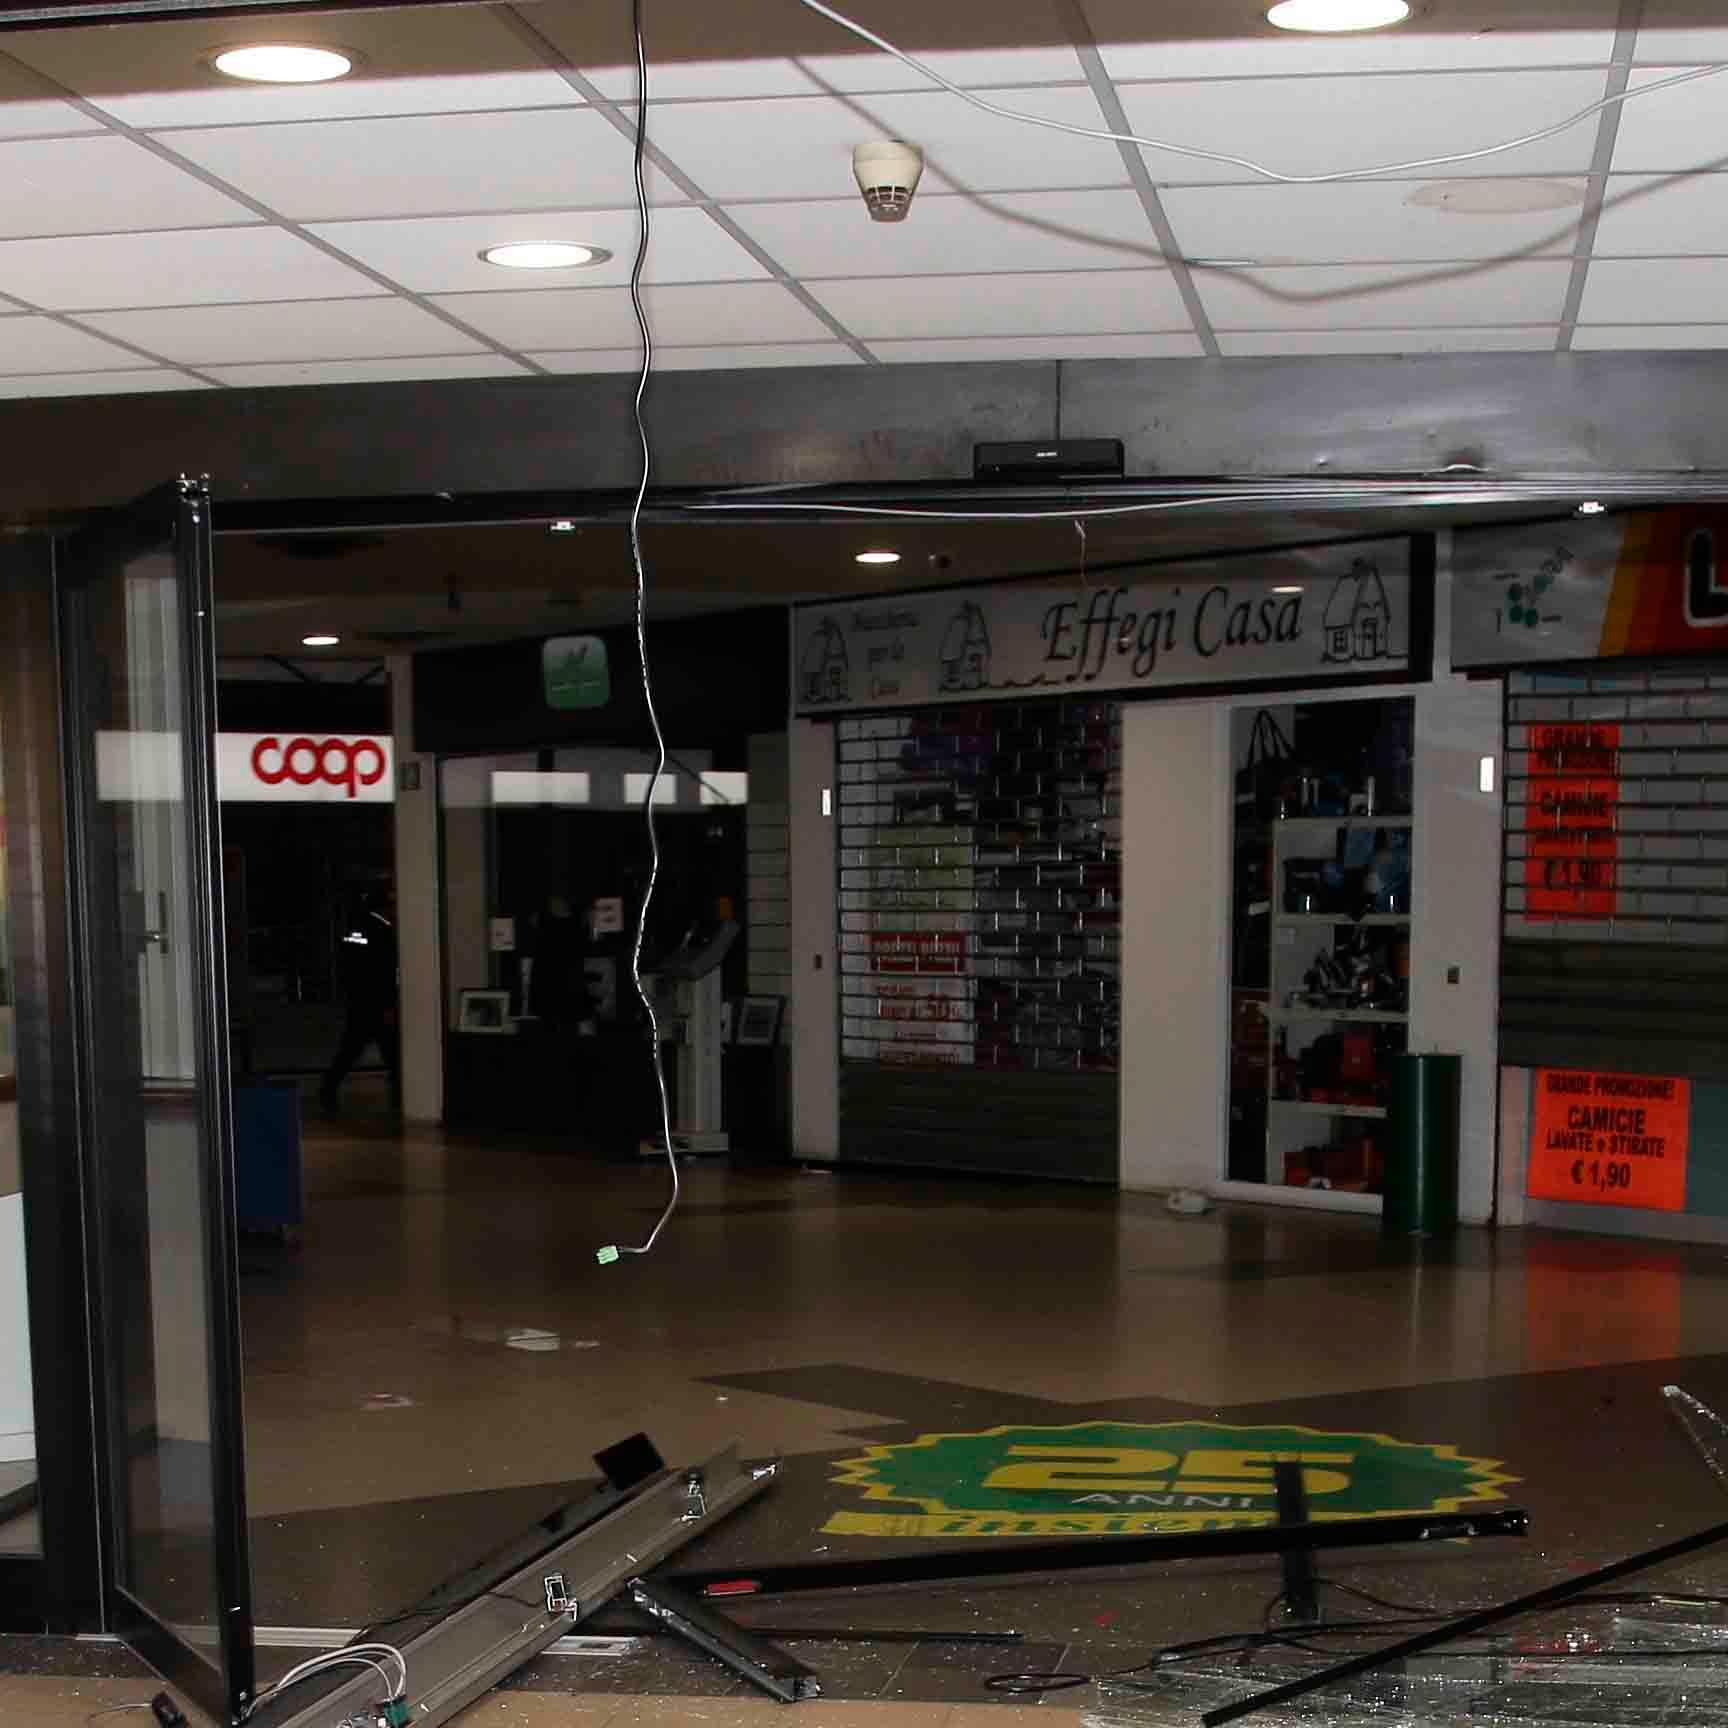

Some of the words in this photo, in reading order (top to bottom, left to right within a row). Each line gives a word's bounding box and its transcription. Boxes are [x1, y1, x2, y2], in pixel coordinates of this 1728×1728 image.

[1040, 585, 1178, 679] Effegi
[1193, 585, 1303, 657] Casa
[250, 736, 386, 799] coop
[1567, 1103, 1647, 1134] CAMICIE
[1545, 1127, 1593, 1153] LAVATE
[1607, 1134, 1665, 1159] STIRATE
[1571, 1159, 1585, 1185] €
[1588, 1160, 1632, 1193] 1,90
[979, 1443, 1356, 1497] 25
[1070, 1492, 1256, 1509] ANNI
